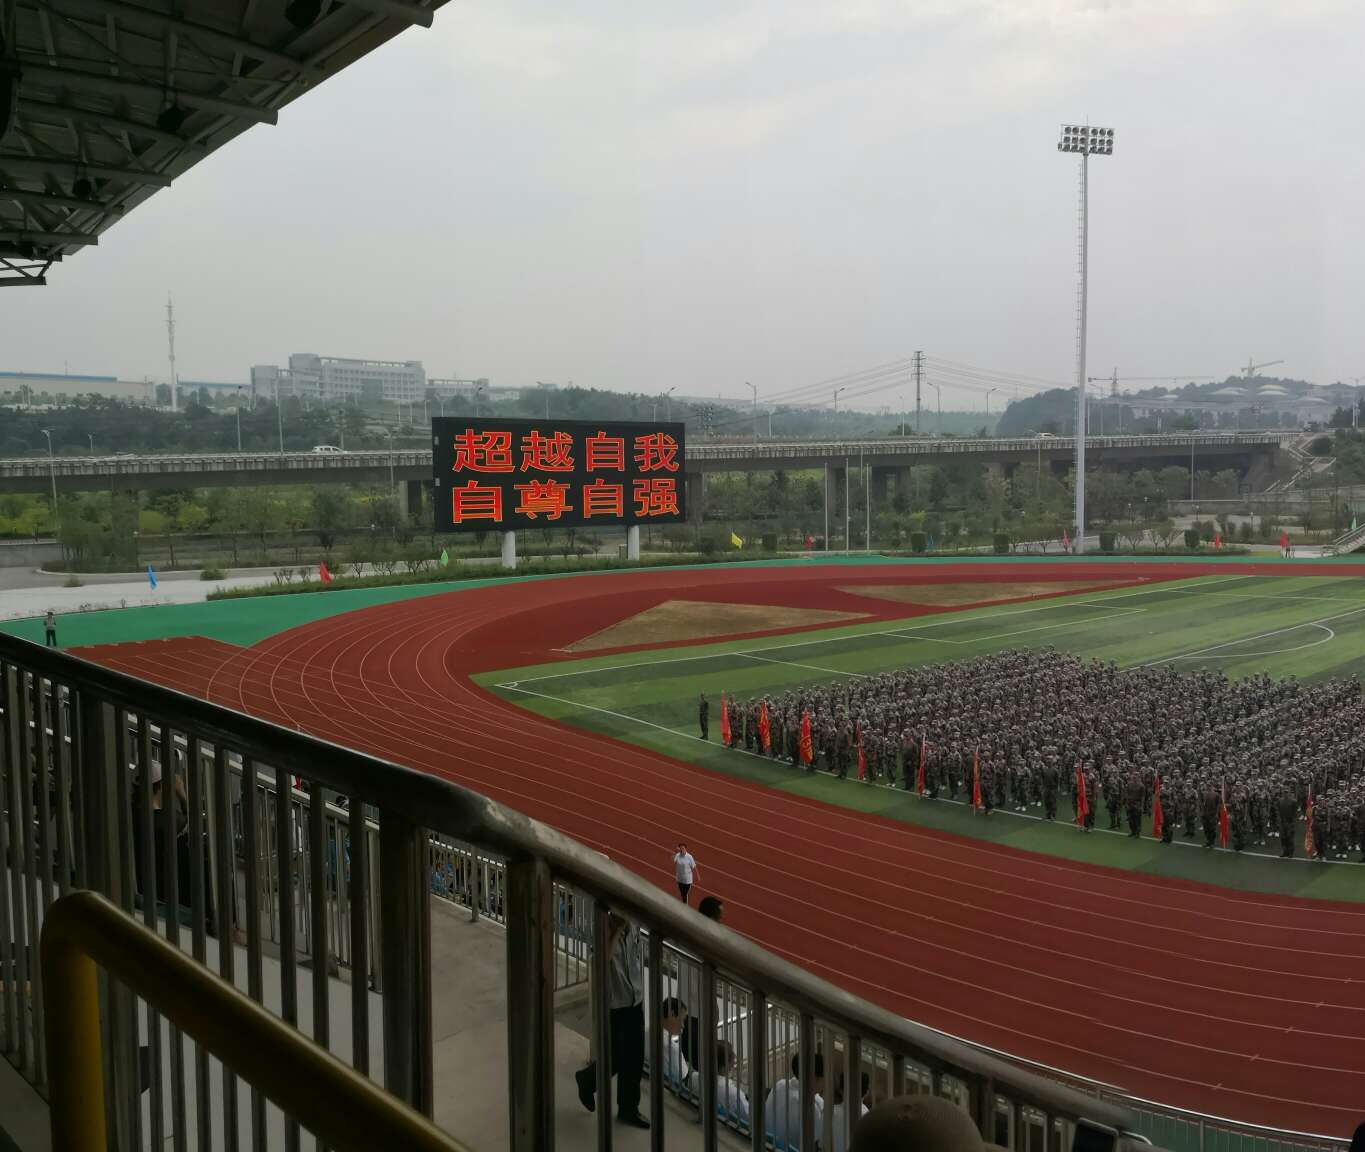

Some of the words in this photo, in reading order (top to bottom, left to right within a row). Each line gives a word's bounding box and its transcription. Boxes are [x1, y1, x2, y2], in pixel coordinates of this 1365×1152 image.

[452, 429, 679, 473] 超越自我
[452, 478, 679, 524] 自尊自强
